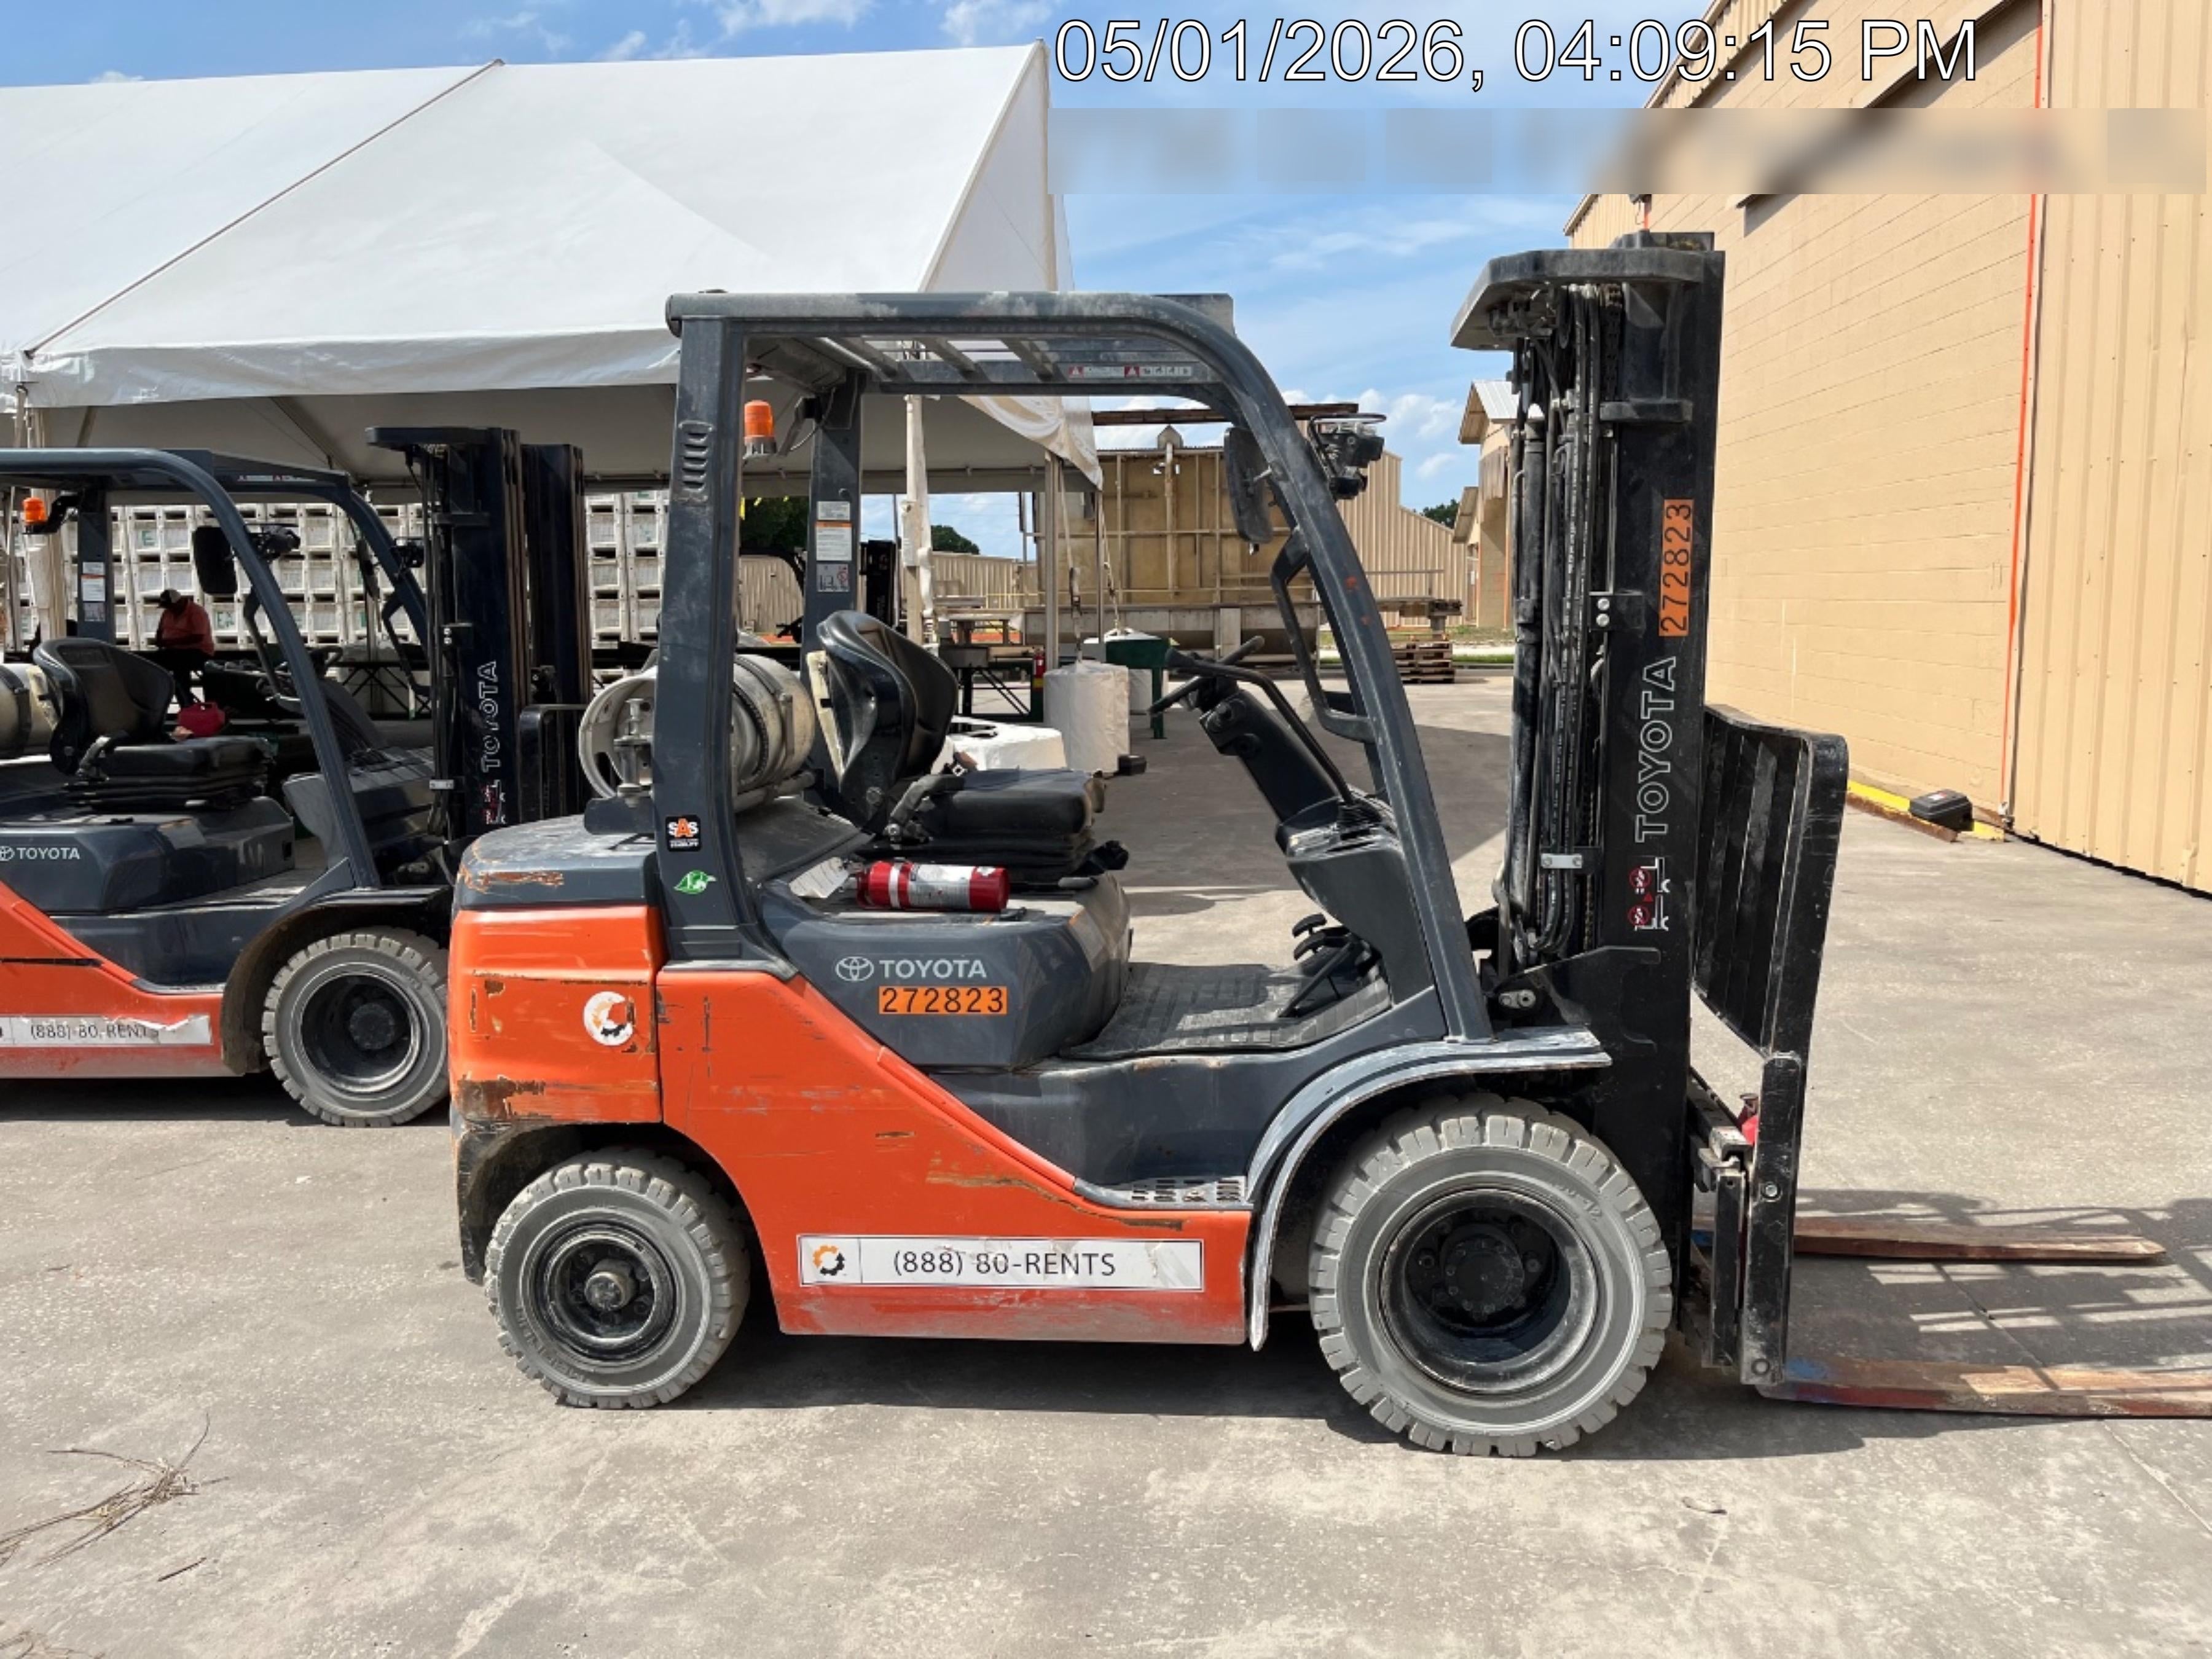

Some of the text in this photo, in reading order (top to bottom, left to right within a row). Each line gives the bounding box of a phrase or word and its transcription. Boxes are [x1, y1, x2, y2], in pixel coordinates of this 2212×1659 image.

[1661, 504, 1691, 632] 272823
[1634, 656, 1677, 844] TOYOTA
[668, 818, 699, 837] SAS
[16, 847, 80, 860] TOYOTA
[879, 959, 987, 979] TOYOTA
[882, 987, 1003, 1013] 272823
[31, 1024, 71, 1040] (888)
[893, 1250, 1116, 1277] (888) 80-RENTS
